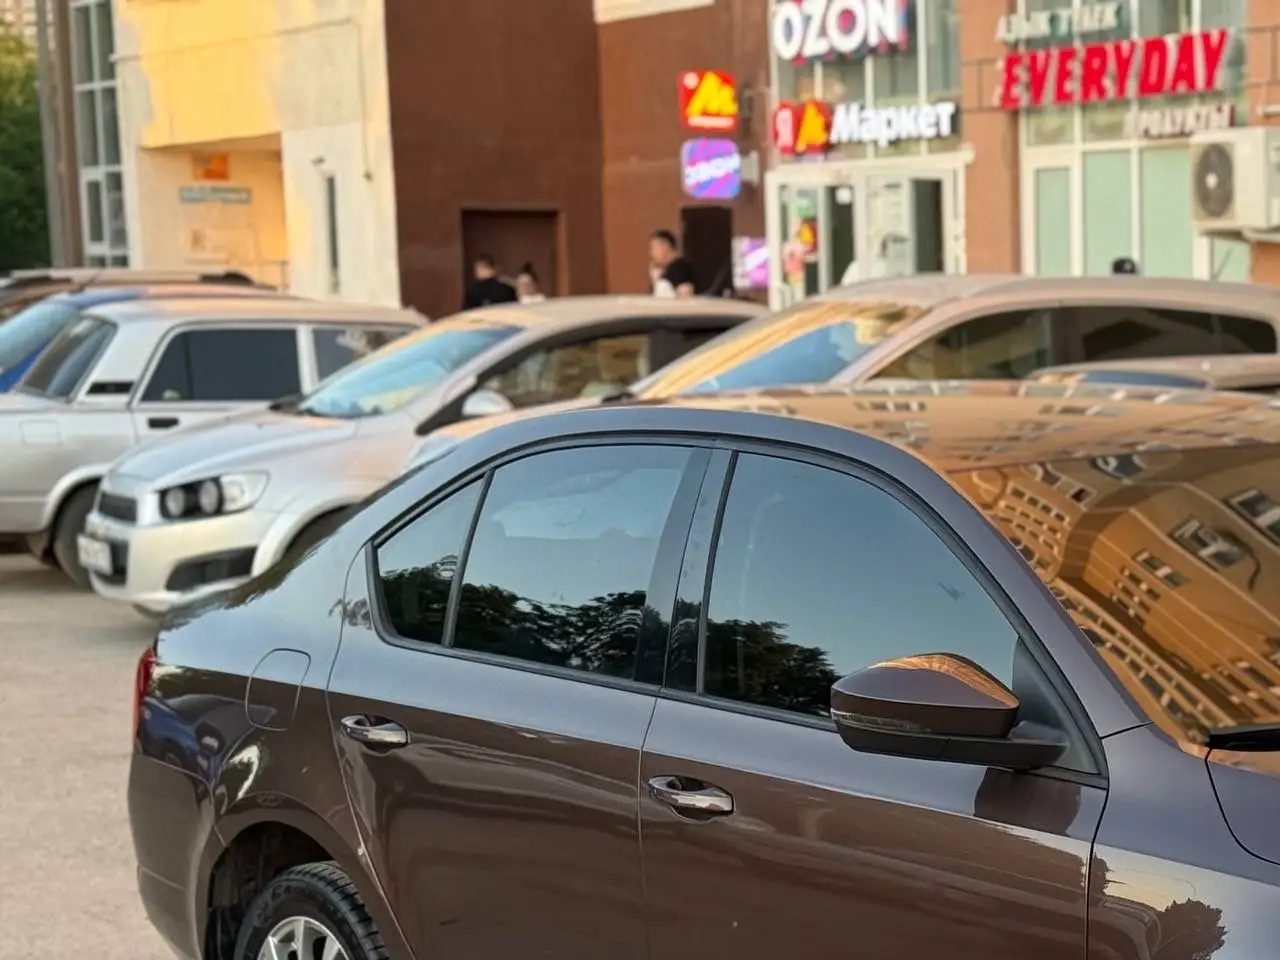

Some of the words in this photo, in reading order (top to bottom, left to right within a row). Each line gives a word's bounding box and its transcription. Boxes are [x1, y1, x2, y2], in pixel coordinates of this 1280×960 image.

[773, 0, 900, 60] OZON
[1000, 28, 1229, 111] EVERYDAY
[829, 101, 956, 148] Маркет
